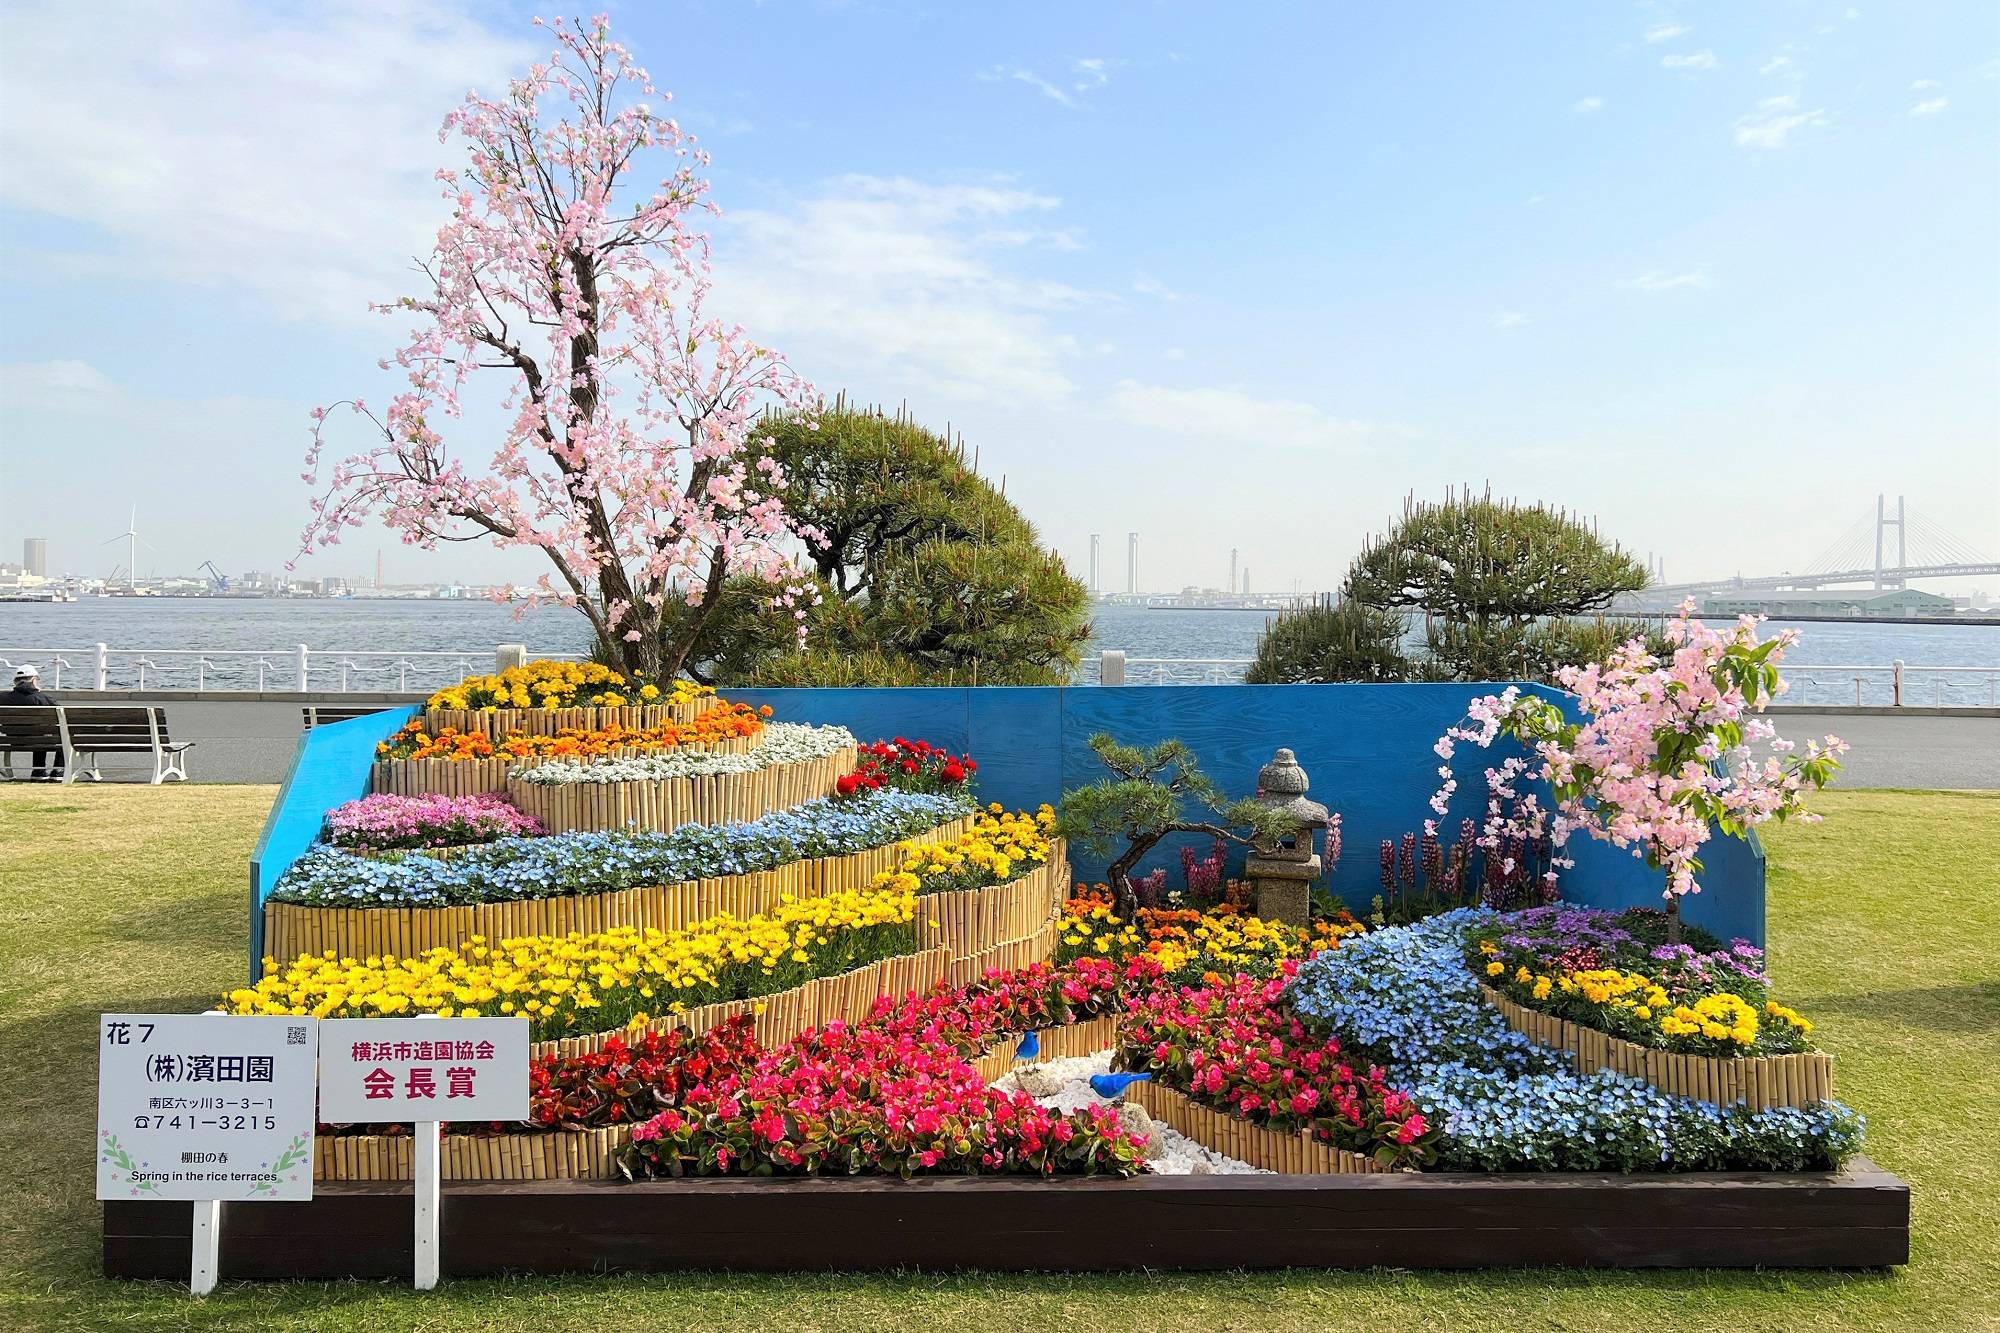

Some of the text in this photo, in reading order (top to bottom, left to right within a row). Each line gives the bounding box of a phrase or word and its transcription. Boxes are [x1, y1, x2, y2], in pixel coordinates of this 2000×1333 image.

[107, 1022, 155, 1045] 花7
[351, 1040, 495, 1062] 横浜市造園協会
[146, 1053, 274, 1083] (株)濱田園
[363, 1066, 476, 1100] 会長賞
[181, 1151, 229, 1164] 棚田の春
[131, 1170, 277, 1183] Spring in the rice terraces
